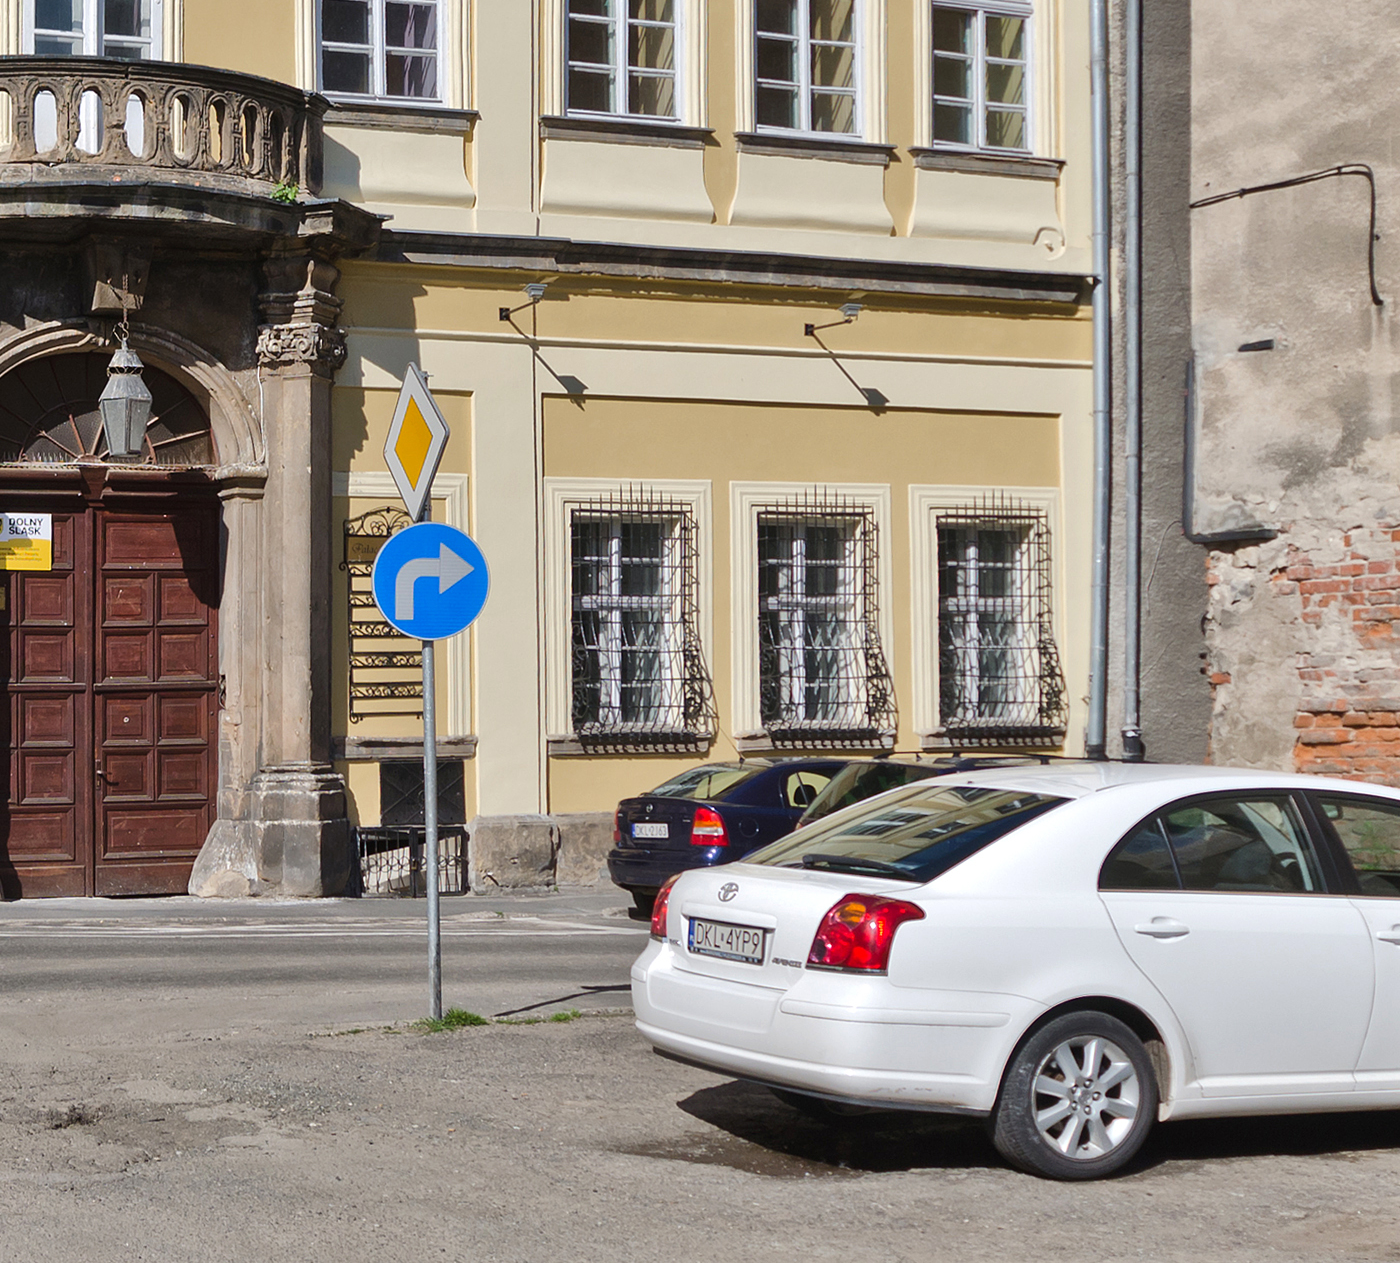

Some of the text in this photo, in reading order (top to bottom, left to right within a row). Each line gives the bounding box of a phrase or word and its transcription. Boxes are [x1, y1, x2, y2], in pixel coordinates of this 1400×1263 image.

[8, 518, 43, 526] DOLNY
[8, 526, 41, 536] ŚLĄSK
[696, 923, 721, 949] DKL
[726, 929, 760, 955] 4YP9
